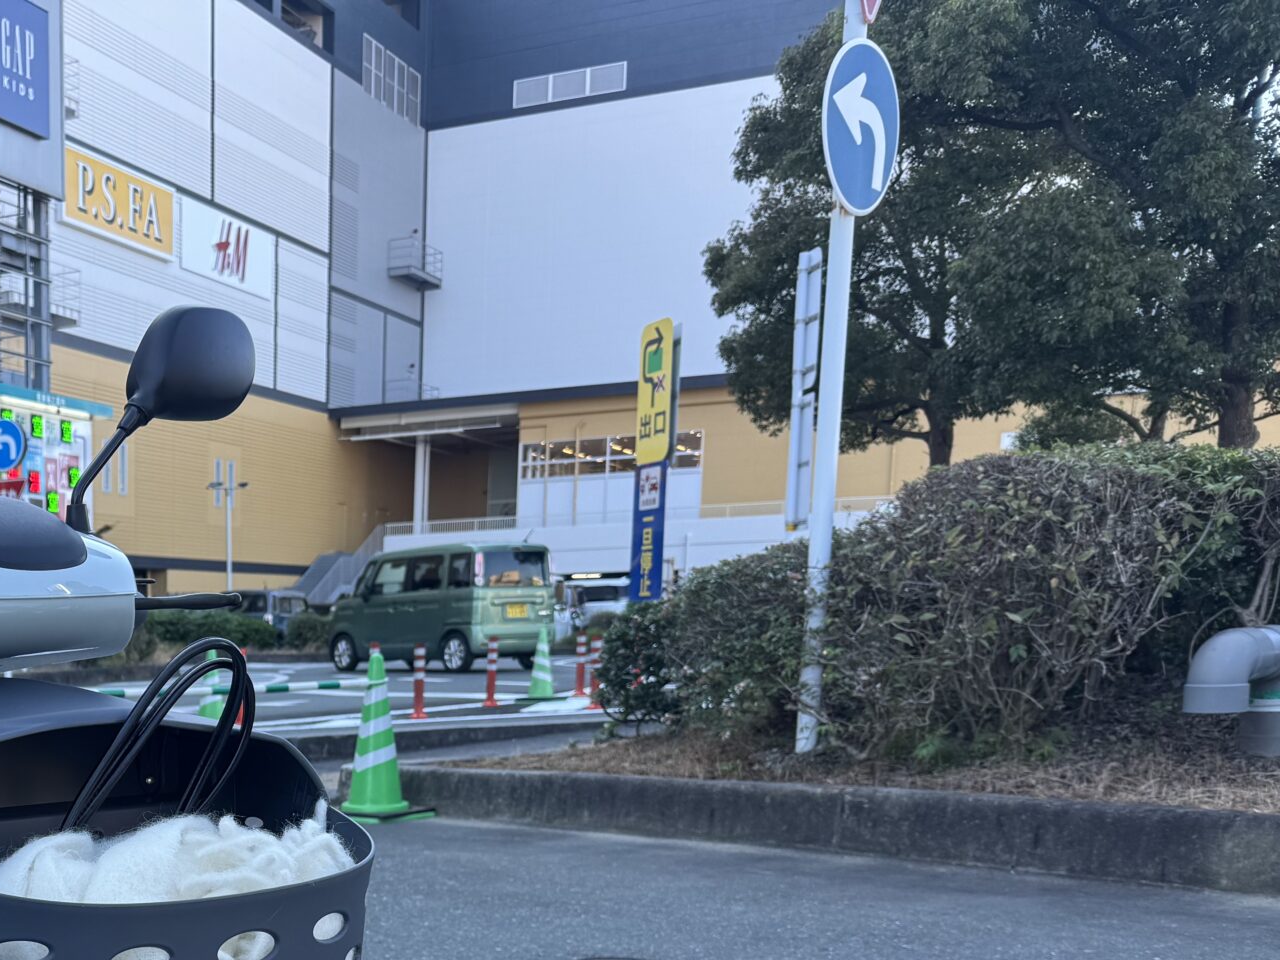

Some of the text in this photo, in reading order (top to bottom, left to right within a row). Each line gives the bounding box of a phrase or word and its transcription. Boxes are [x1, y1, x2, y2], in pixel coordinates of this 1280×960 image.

[1, 17, 34, 80] GAP
[2, 74, 35, 101] KIDS
[76, 159, 163, 244] P.S.FA
[639, 410, 666, 440] 出口
[638, 515, 654, 597] 一旦停止
